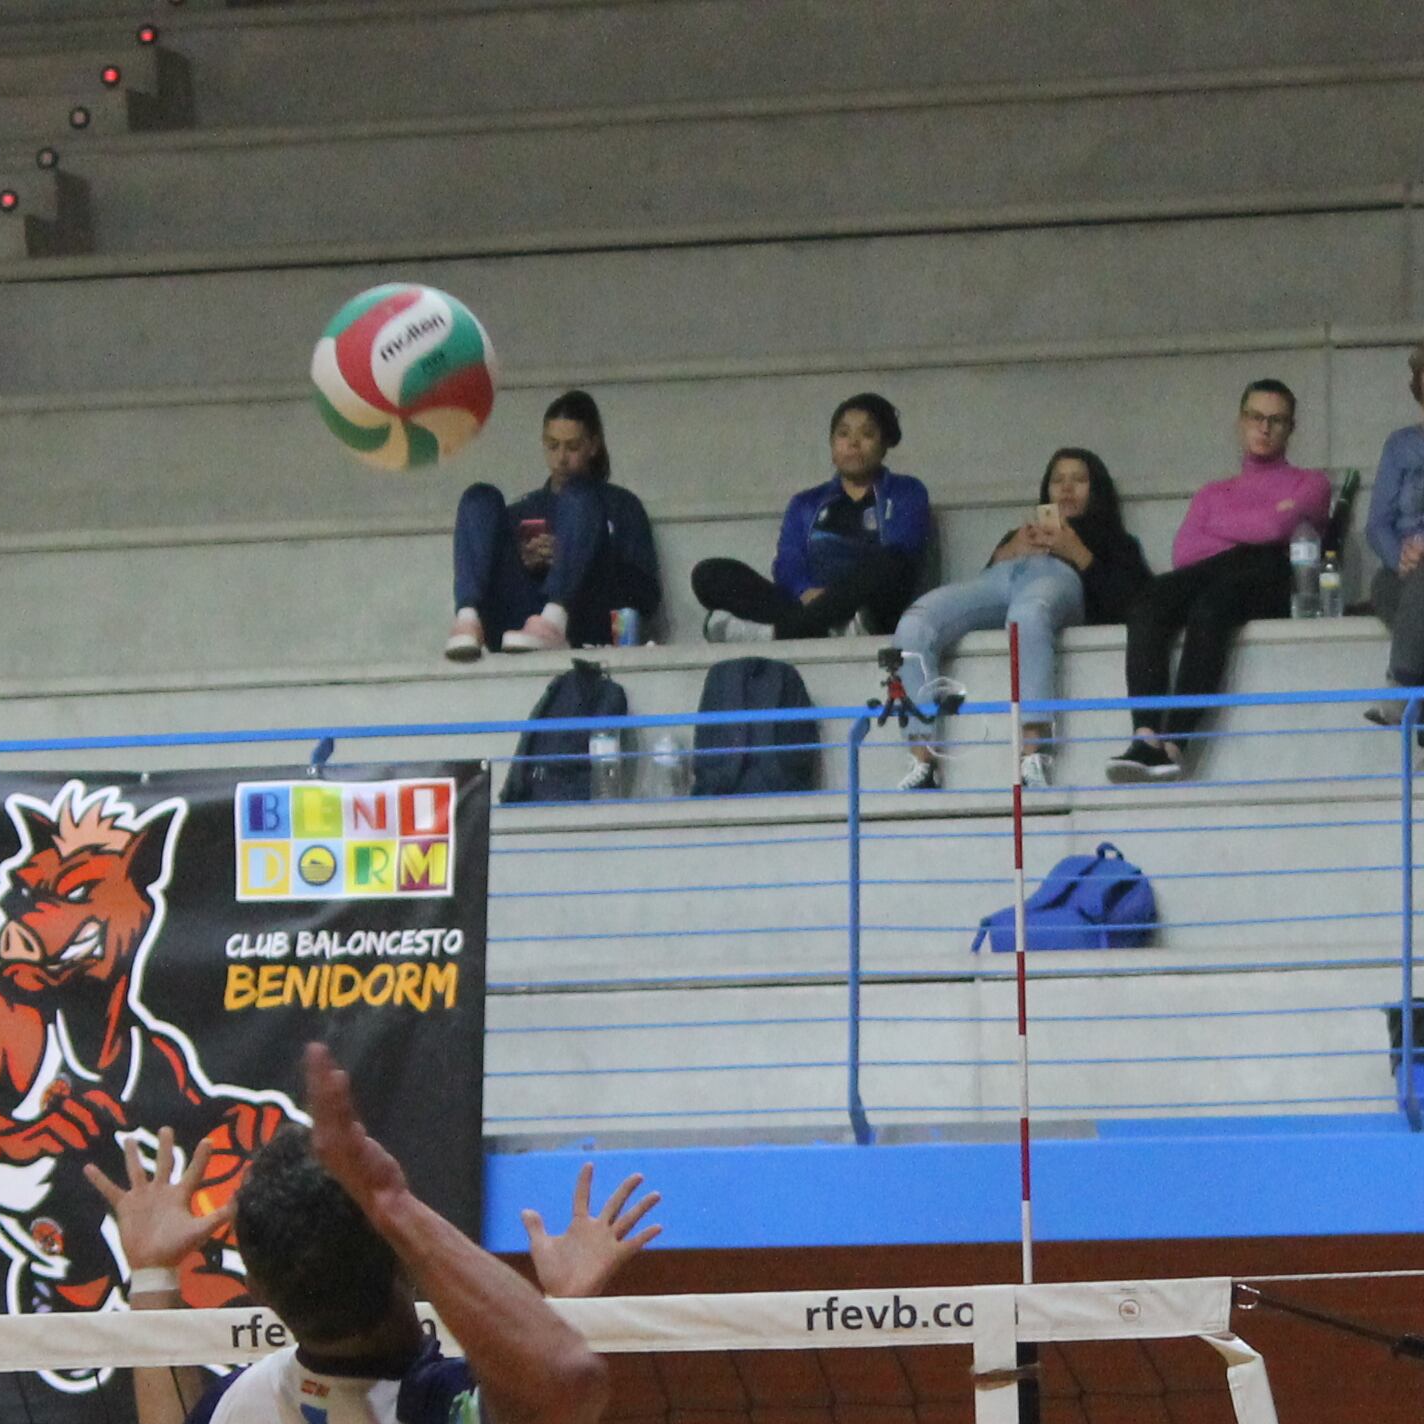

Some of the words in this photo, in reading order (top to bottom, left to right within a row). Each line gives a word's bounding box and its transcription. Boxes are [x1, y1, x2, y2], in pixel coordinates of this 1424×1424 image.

[380, 313, 446, 363] molten
[225, 931, 290, 959] CLUB
[295, 928, 464, 961] BALONCESTO
[224, 962, 459, 1013] BENIDORM
[806, 1294, 1019, 1333] rfevb.co
